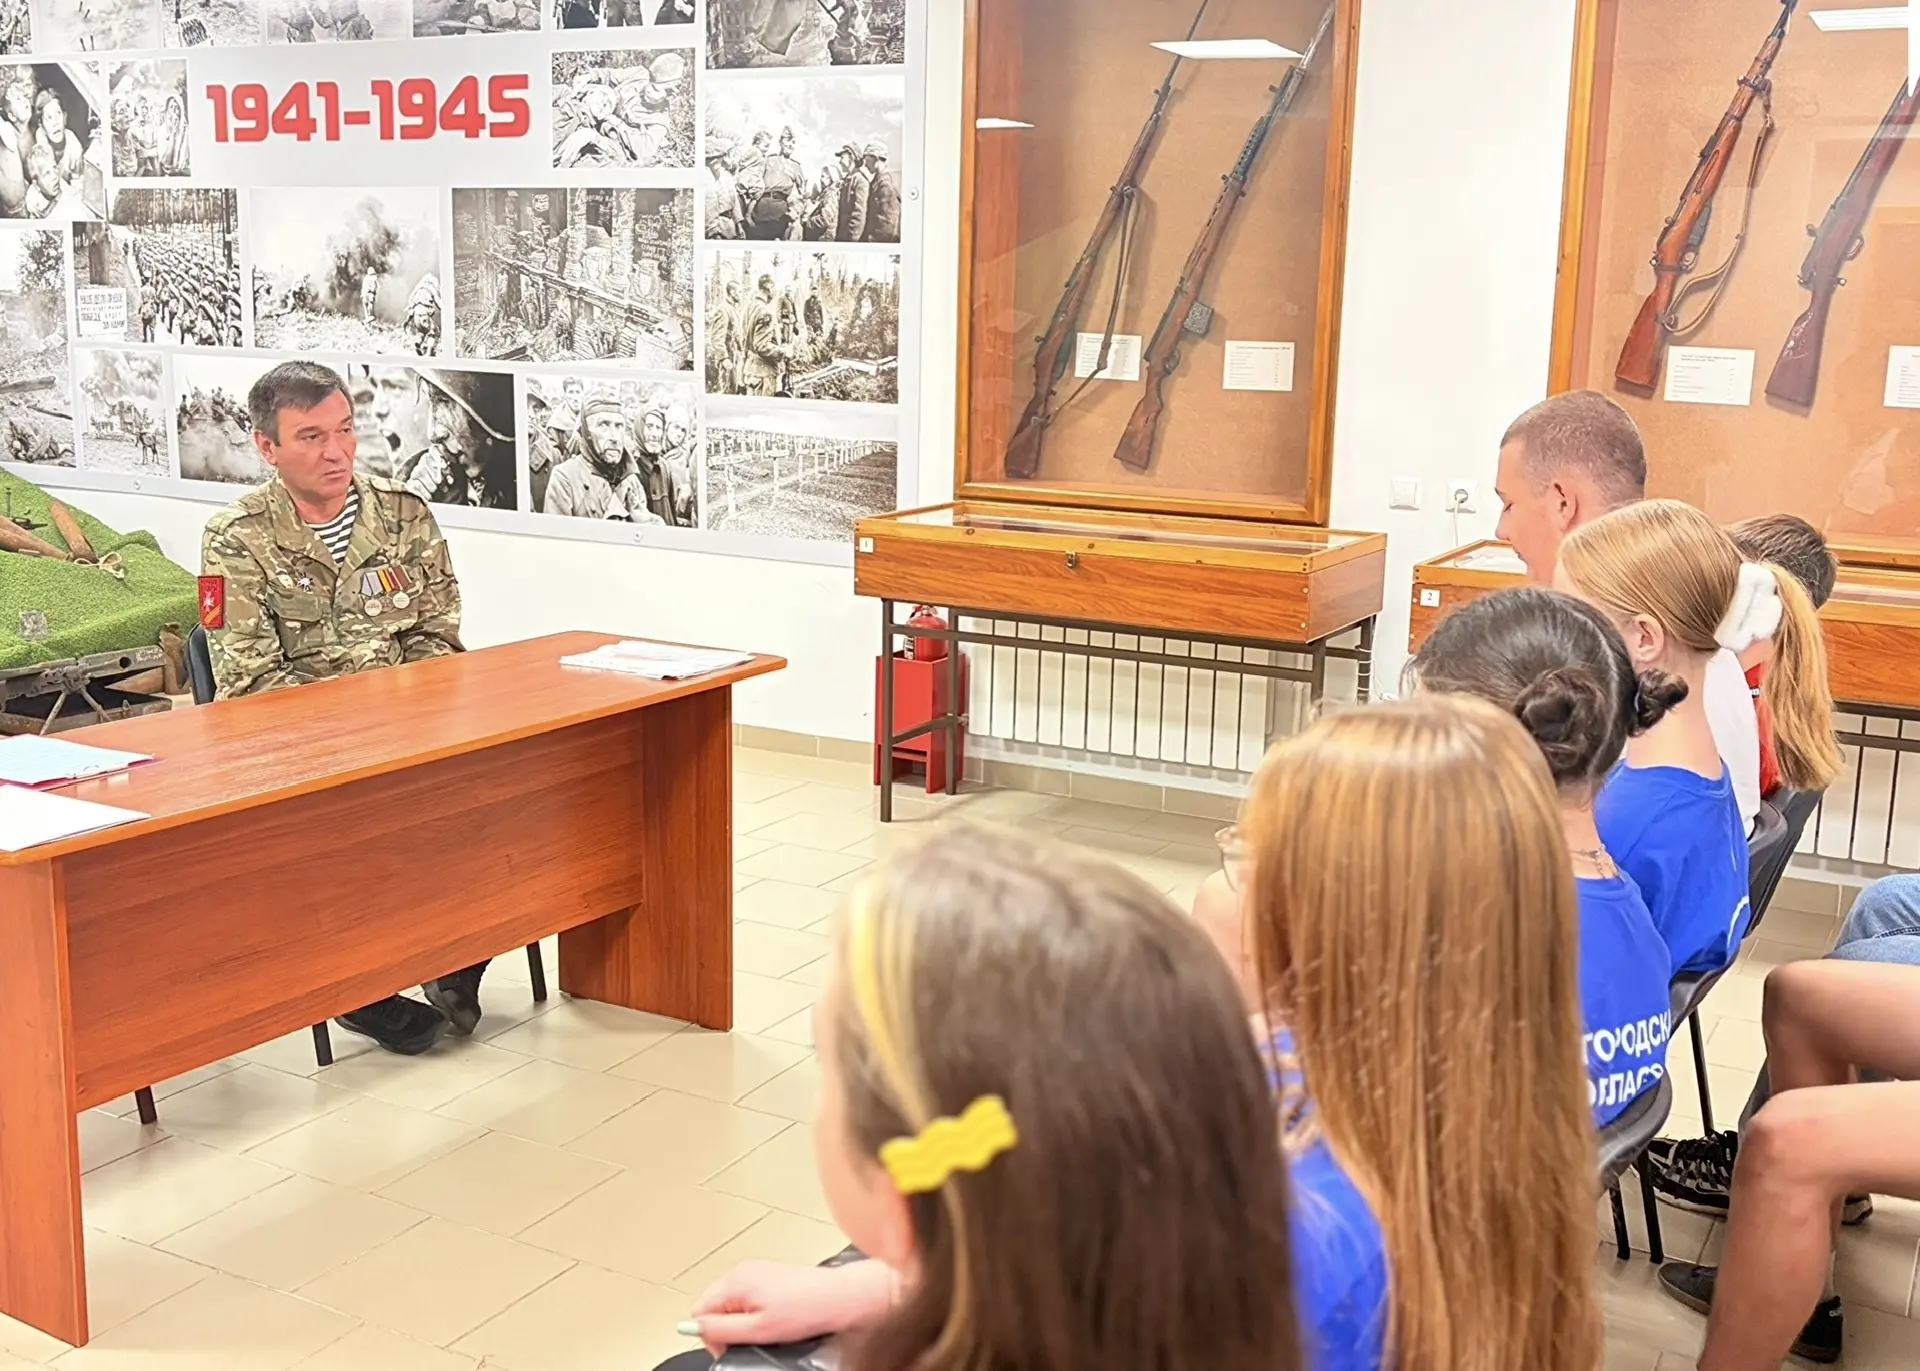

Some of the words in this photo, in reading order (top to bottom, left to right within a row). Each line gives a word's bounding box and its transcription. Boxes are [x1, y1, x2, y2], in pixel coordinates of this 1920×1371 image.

[206, 74, 530, 142] 1941-1945
[1427, 592, 1433, 601] 2
[1582, 1008, 1671, 1066] ГООДСК
